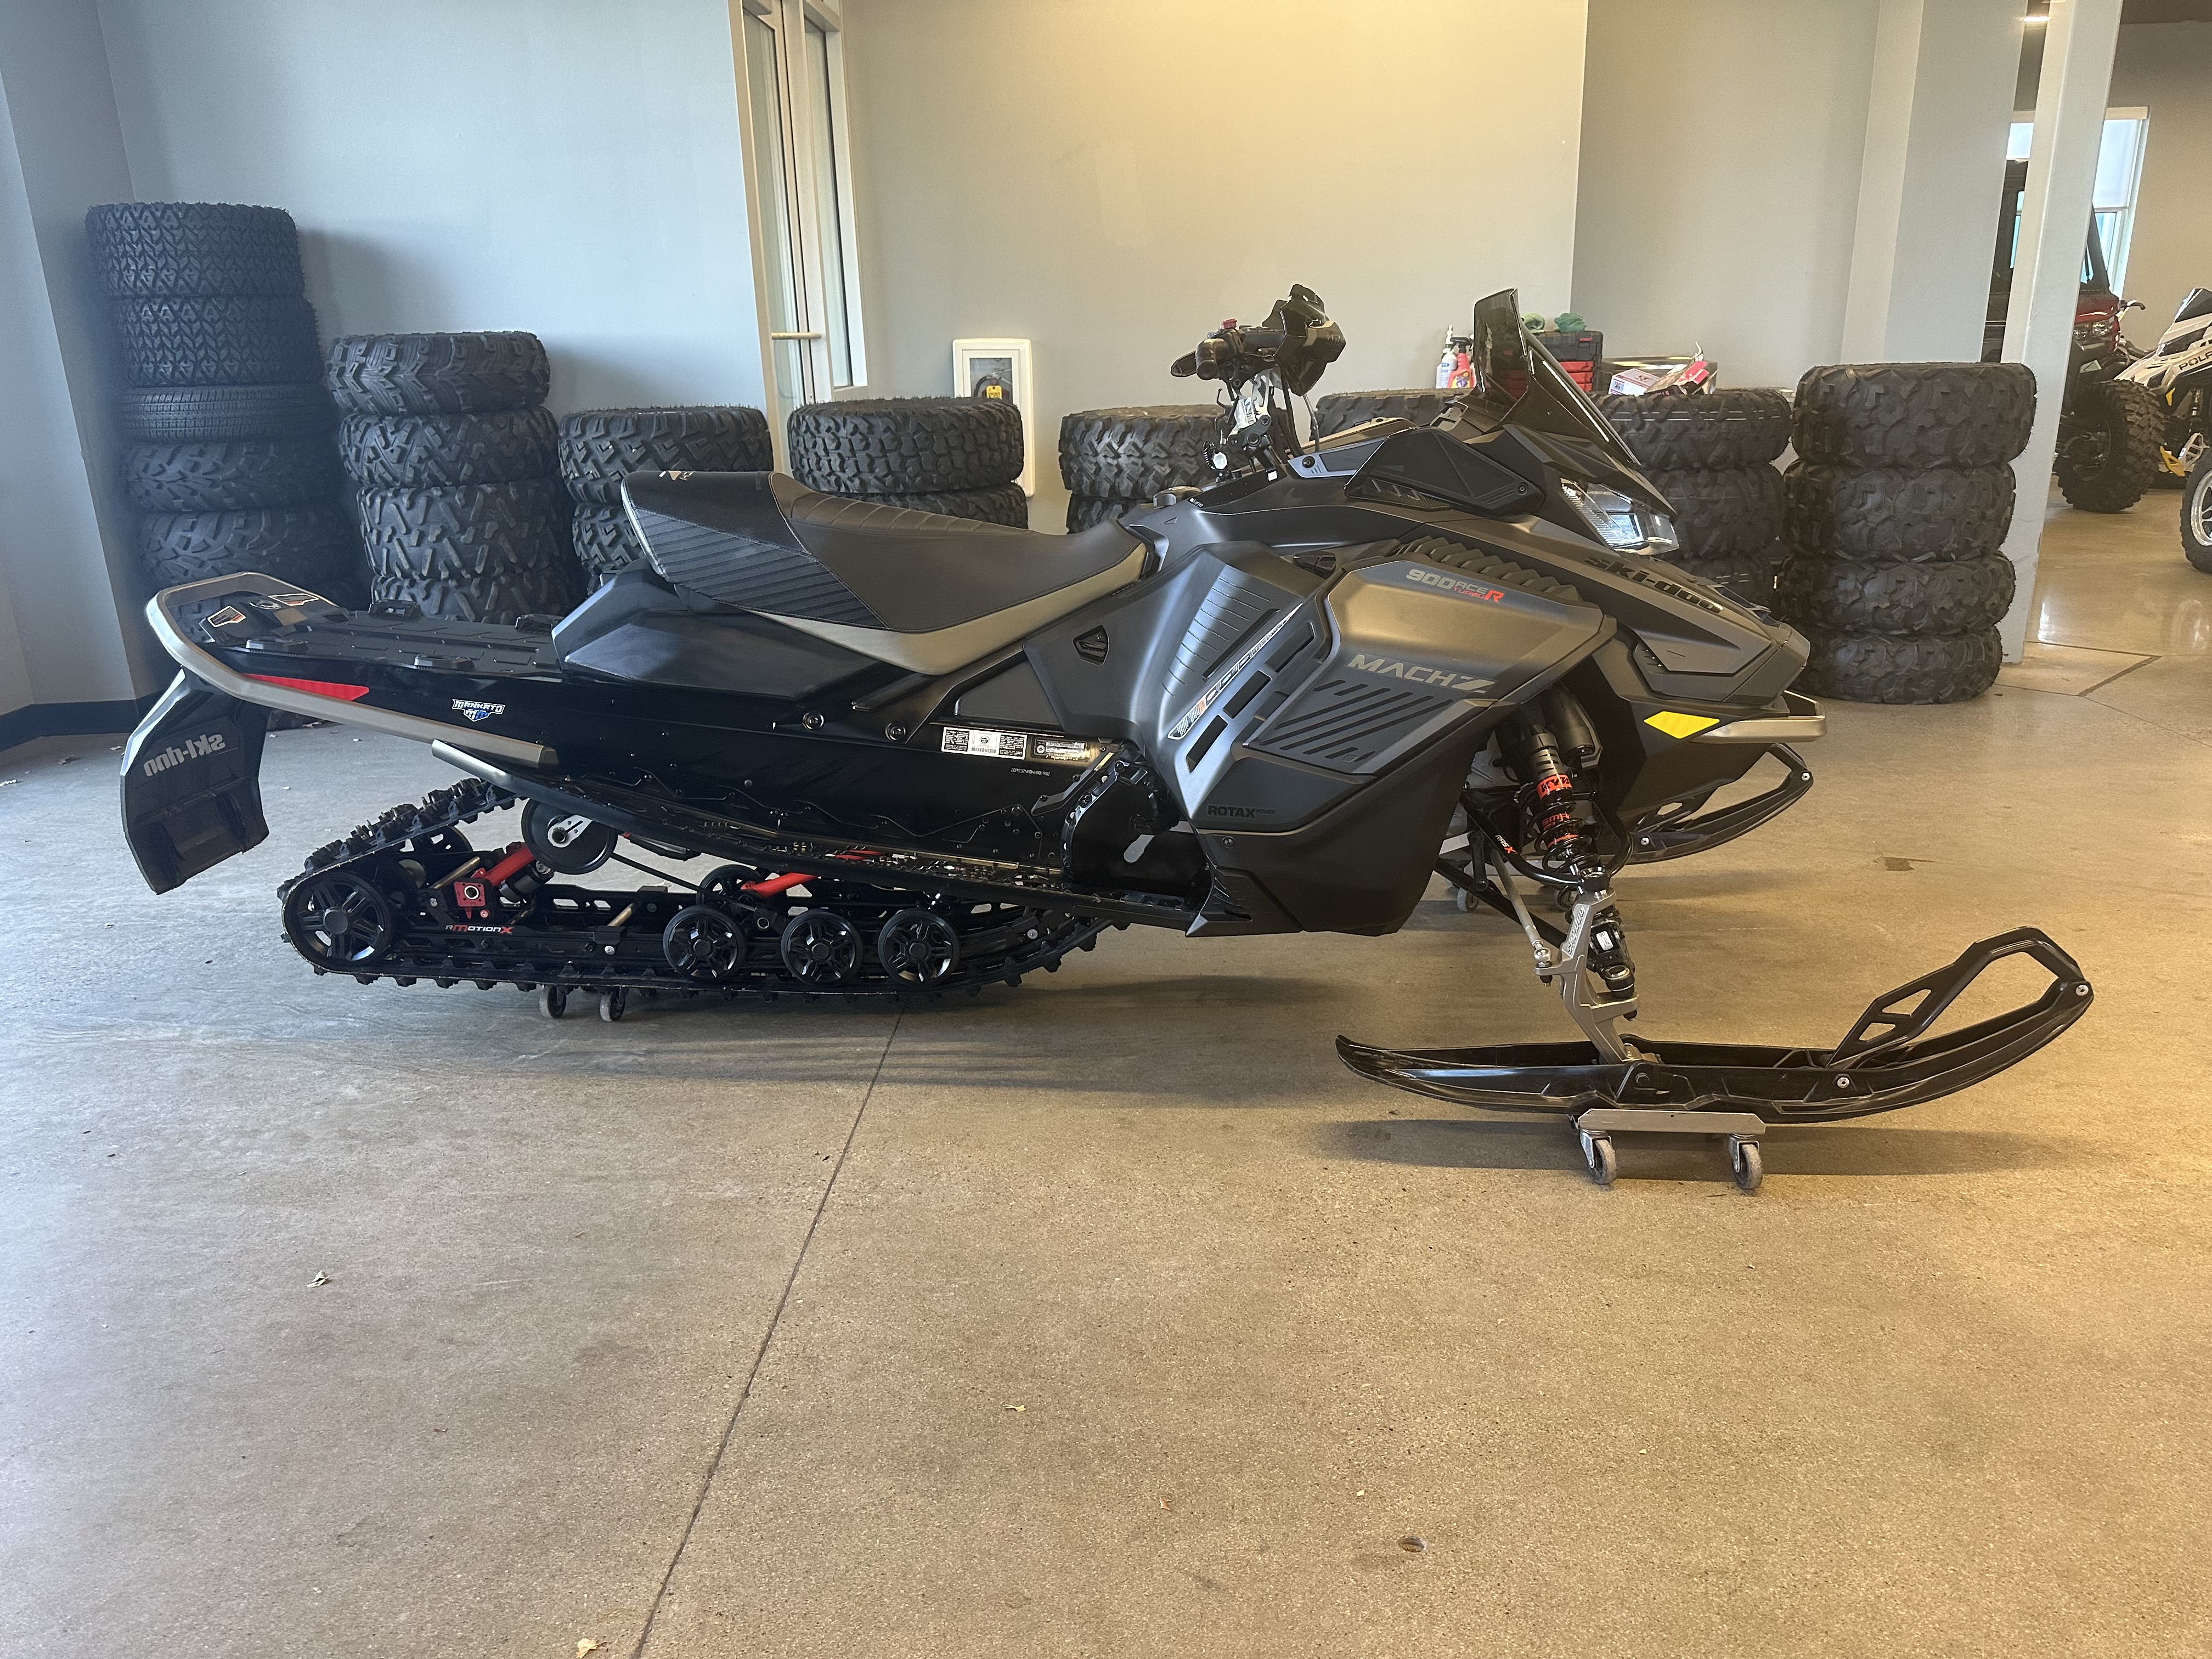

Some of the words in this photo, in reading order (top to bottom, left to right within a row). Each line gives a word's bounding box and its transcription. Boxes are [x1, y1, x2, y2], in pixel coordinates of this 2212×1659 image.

[1407, 569, 1457, 589] 900
[455, 701, 503, 712] MANKATO
[1207, 805, 1256, 819] ROTAX
